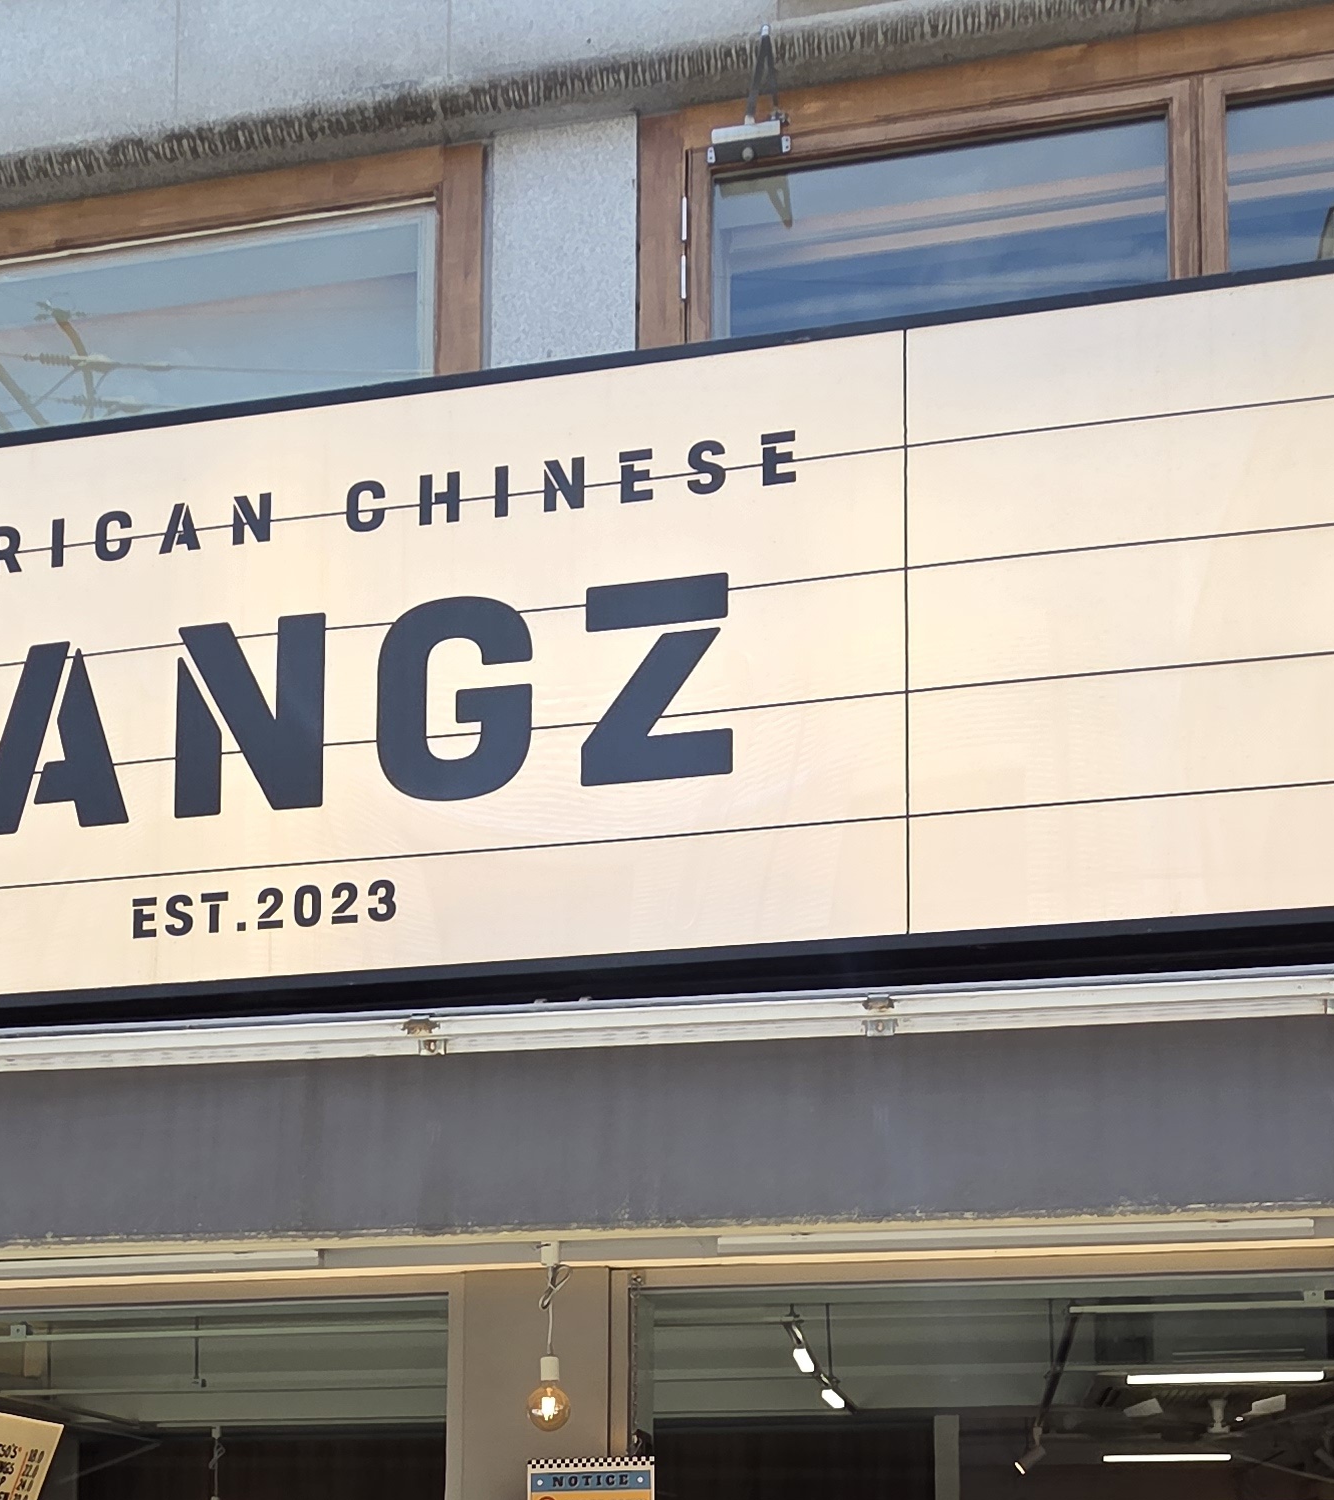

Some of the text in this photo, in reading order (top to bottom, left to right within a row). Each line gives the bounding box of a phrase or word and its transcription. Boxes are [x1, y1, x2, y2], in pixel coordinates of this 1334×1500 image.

[346, 430, 797, 533] CHINESE
[132, 878, 397, 940] EST.2023
[552, 1474, 629, 1488] NOTICE
